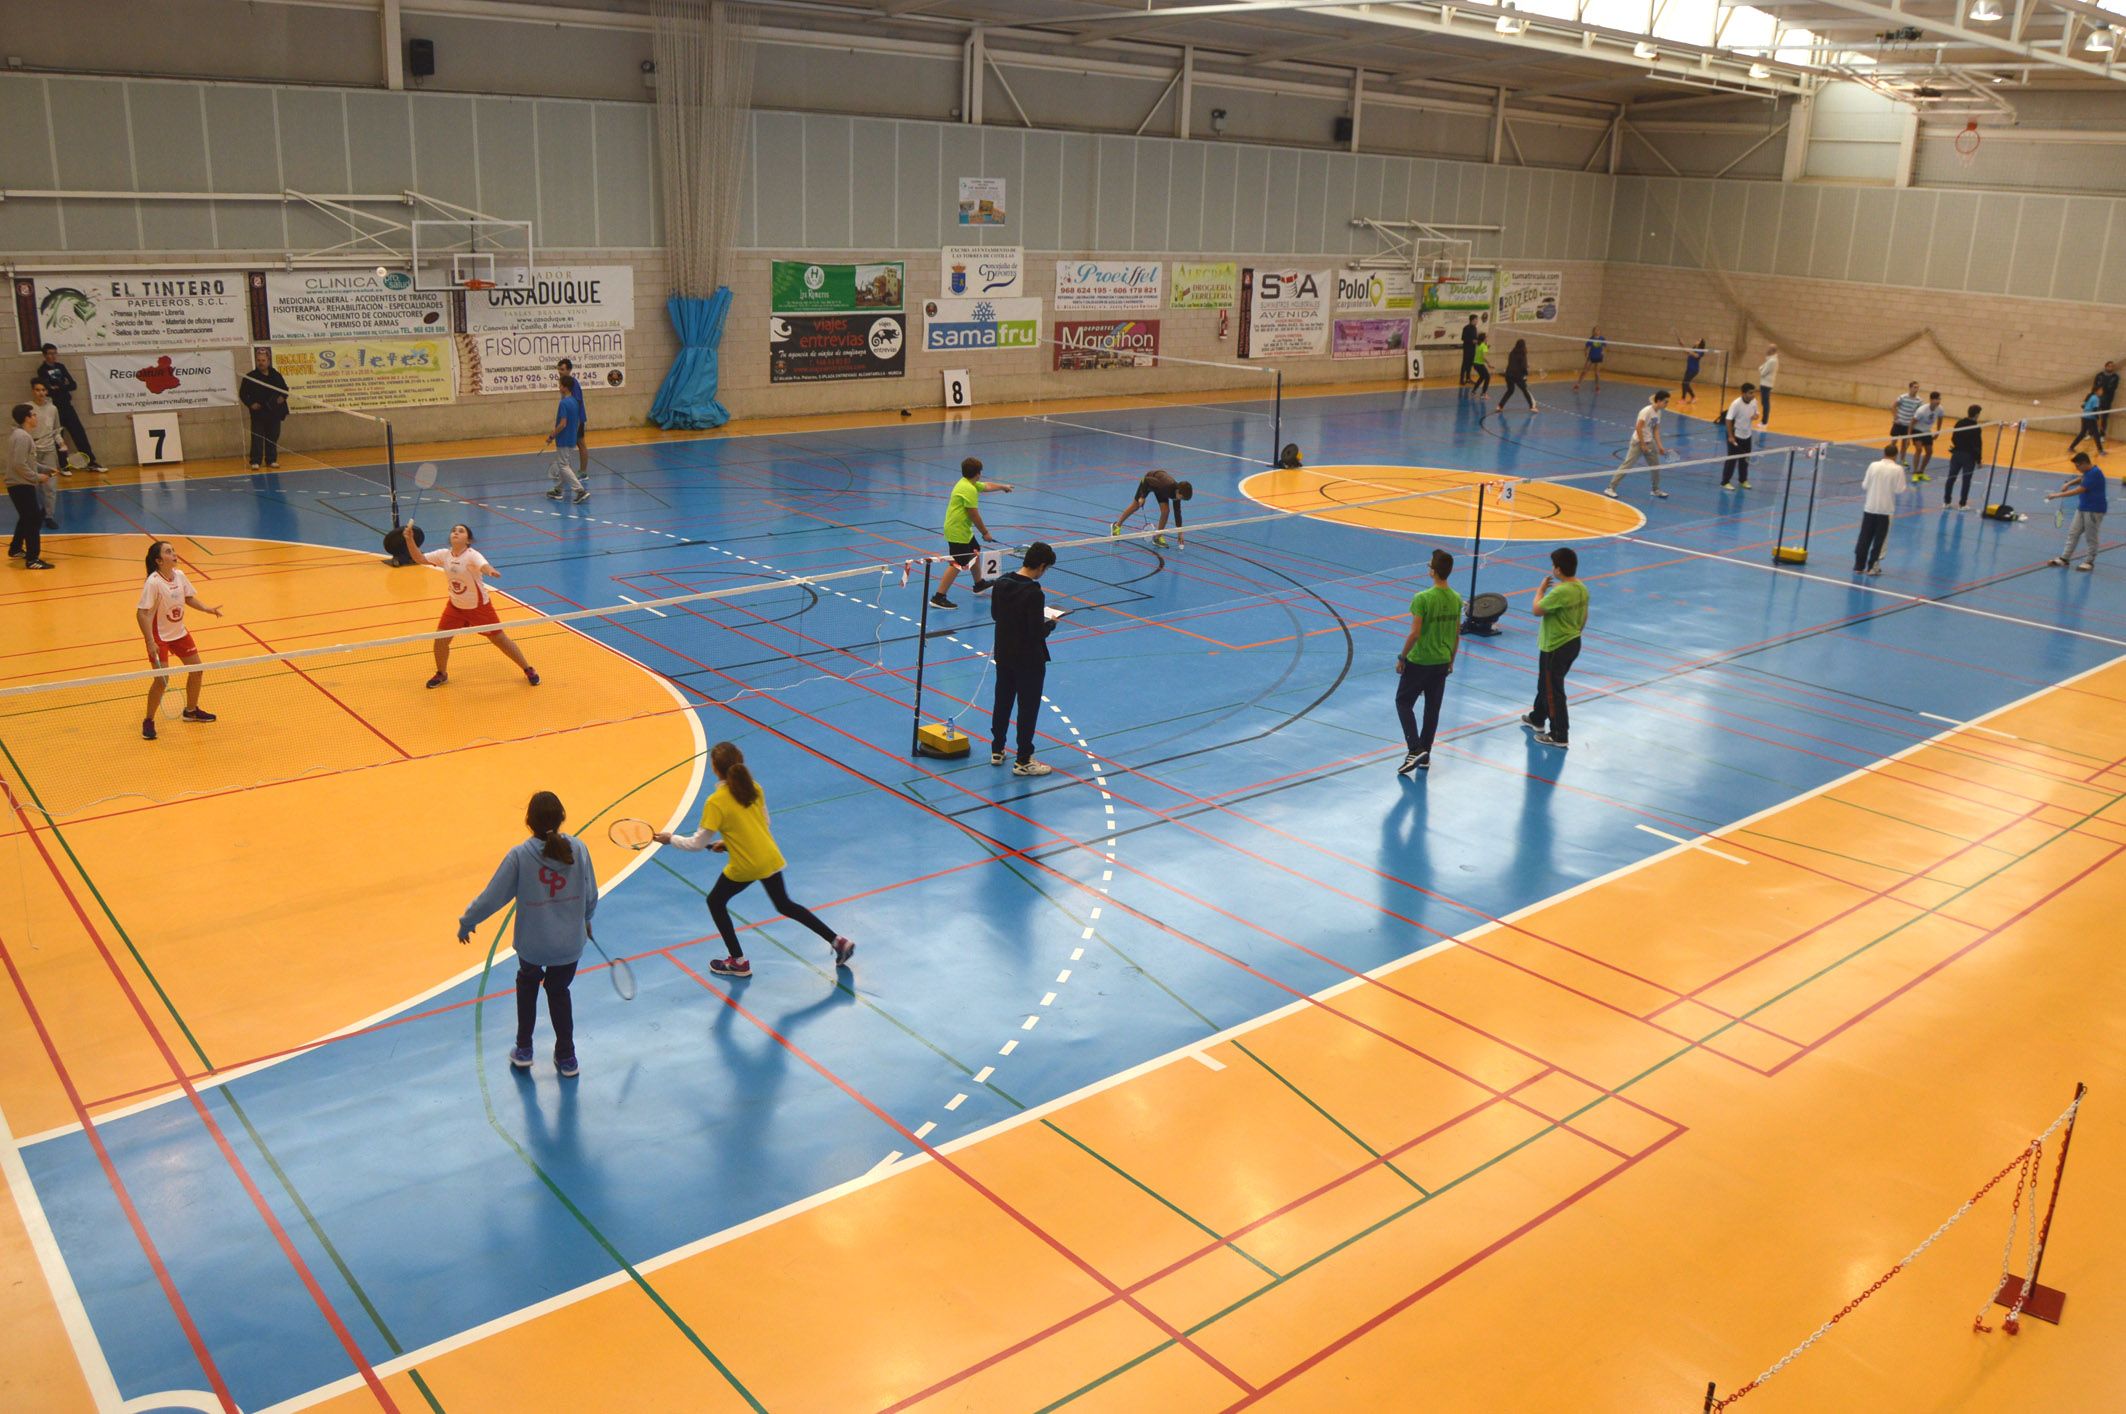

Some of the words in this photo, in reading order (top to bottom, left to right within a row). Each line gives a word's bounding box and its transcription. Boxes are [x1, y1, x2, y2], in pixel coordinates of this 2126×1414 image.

[517, 274, 524, 284] 2
[1073, 262, 1158, 286] Proeiffel
[111, 282, 132, 297] EL
[142, 280, 224, 296] TINTERO
[305, 276, 378, 289] CLINICA
[279, 296, 316, 304] MEDICINA
[316, 296, 348, 304] GENERAL
[356, 294, 396, 302] ACCIDENTES
[488, 280, 600, 306] CASADUQUE
[128, 298, 194, 308] PAPELEROS,
[273, 306, 320, 314] FISIOTERAPIA
[389, 302, 444, 310] ESPECIALIDADES
[296, 312, 360, 321] RECONOCIMIENTO
[372, 310, 424, 318] CONDUCTORES
[1260, 310, 1318, 319] AVENIDA
[330, 320, 361, 328] PERMISO
[812, 318, 848, 333] viajes
[116, 328, 133, 336] Sellos
[141, 328, 160, 336] caucho
[166, 327, 214, 335] Encuadernaciones
[931, 324, 1033, 346] samafru
[1062, 326, 1154, 350] Marathon
[485, 334, 622, 356] FISIOMATURANA
[276, 352, 316, 364] ESCUELA
[1413, 359, 1420, 377] 9
[494, 376, 508, 384] 679
[952, 380, 964, 404] 8
[148, 430, 166, 460] 7
[1506, 488, 1512, 499] 3
[987, 560, 997, 574] 2
